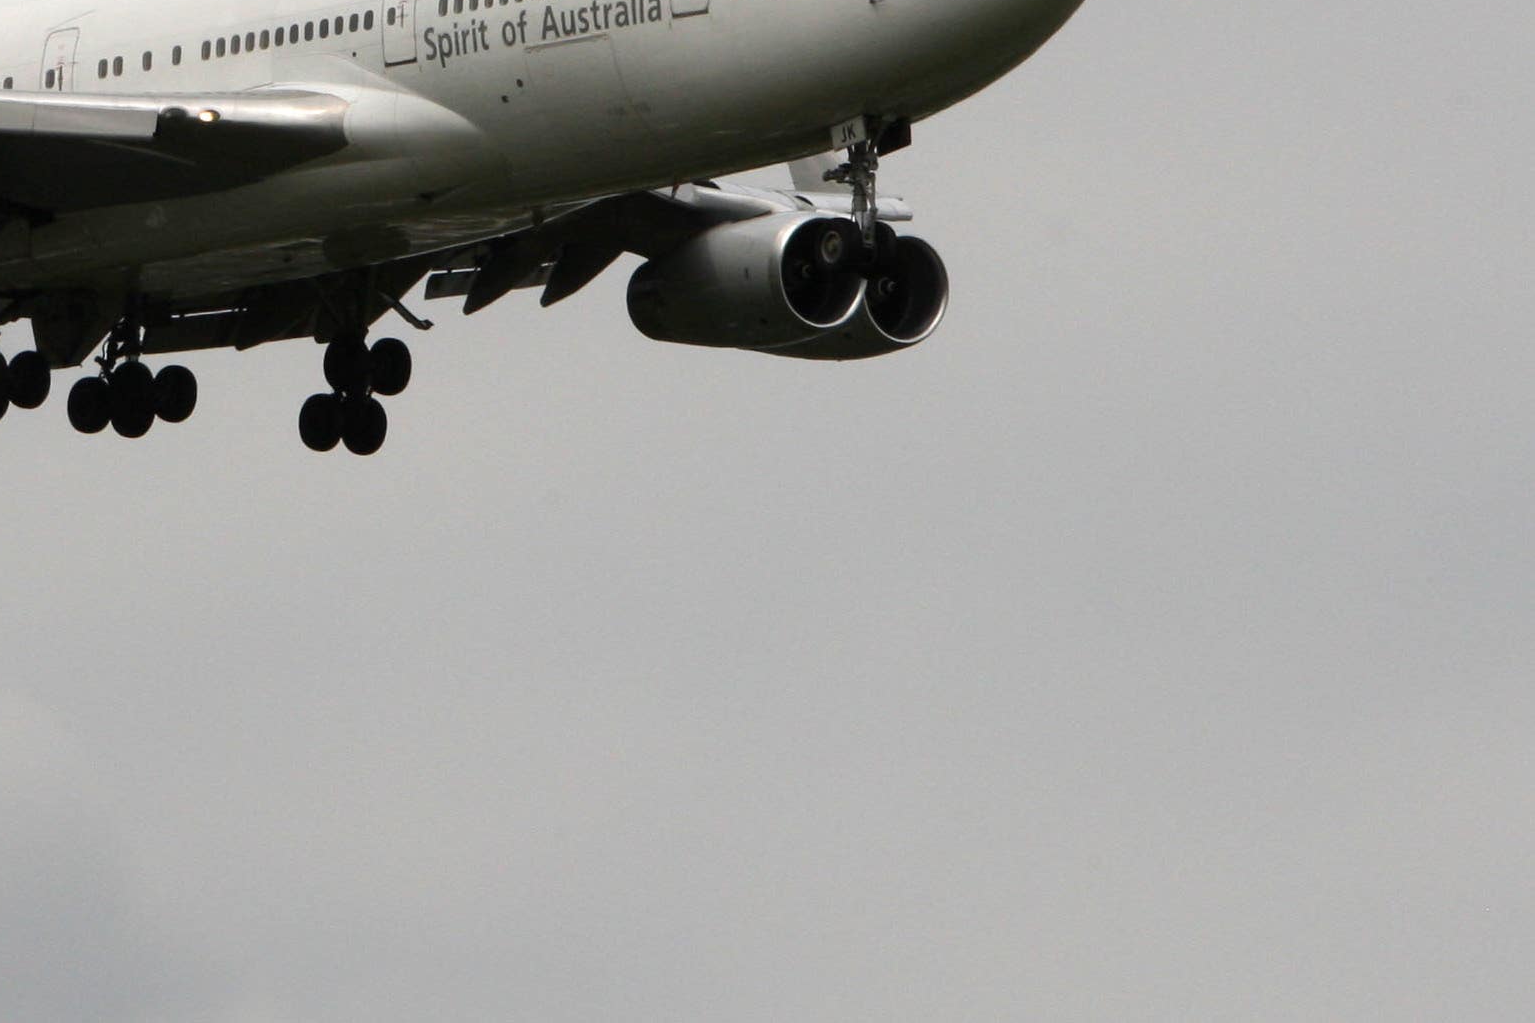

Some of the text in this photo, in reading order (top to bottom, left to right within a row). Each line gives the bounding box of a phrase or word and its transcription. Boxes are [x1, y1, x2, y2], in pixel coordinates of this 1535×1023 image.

[423, 17, 490, 68] Spirit
[502, 10, 528, 47] of
[841, 122, 856, 143] JK
